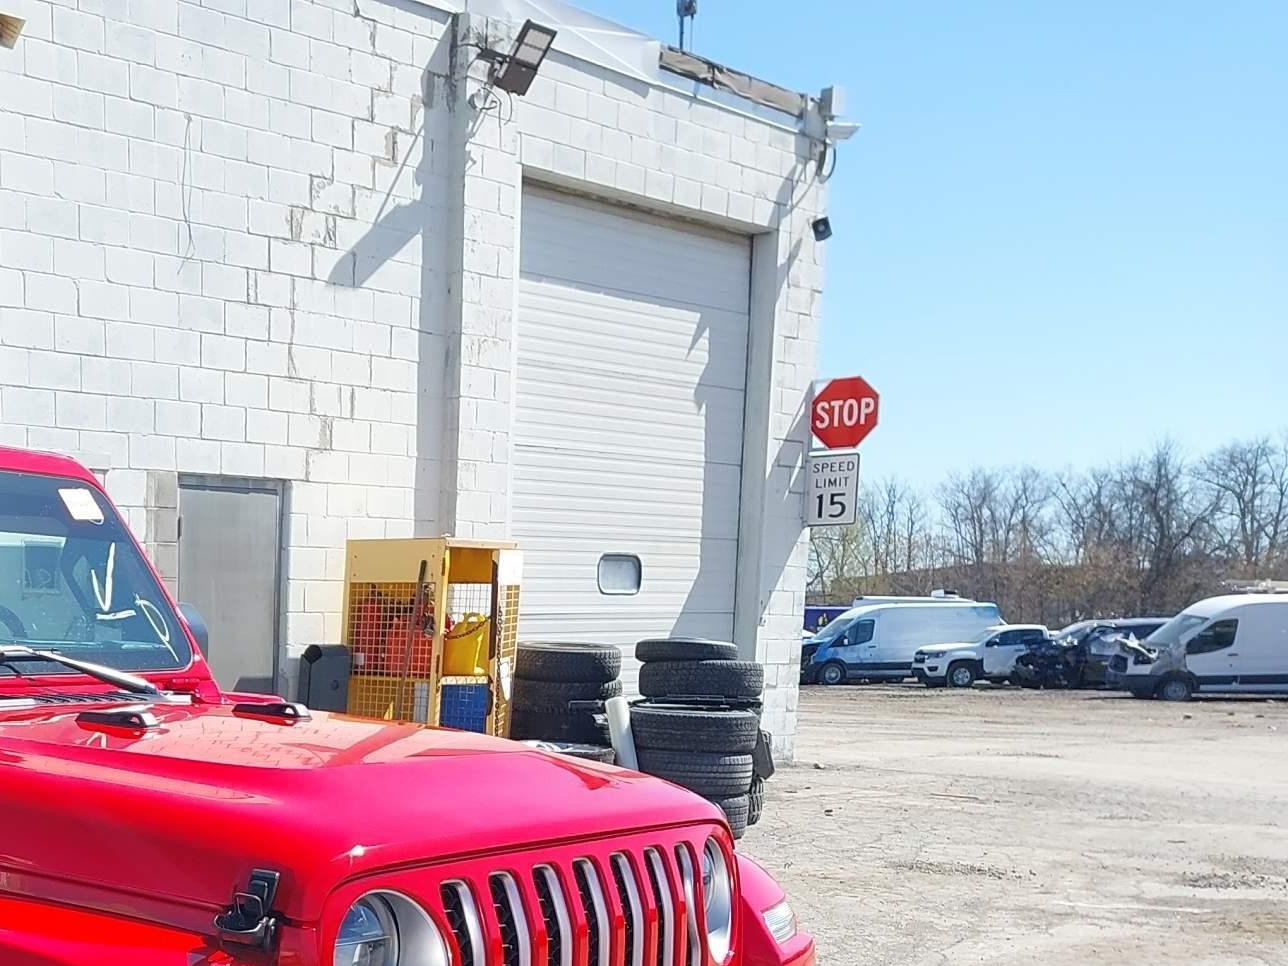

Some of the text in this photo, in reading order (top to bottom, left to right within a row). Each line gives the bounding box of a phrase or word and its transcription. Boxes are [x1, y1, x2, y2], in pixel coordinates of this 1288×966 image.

[815, 397, 875, 429] STOP
[813, 460, 855, 474] SPEED
[815, 476, 850, 489] LIMIT
[816, 492, 847, 519] 15
